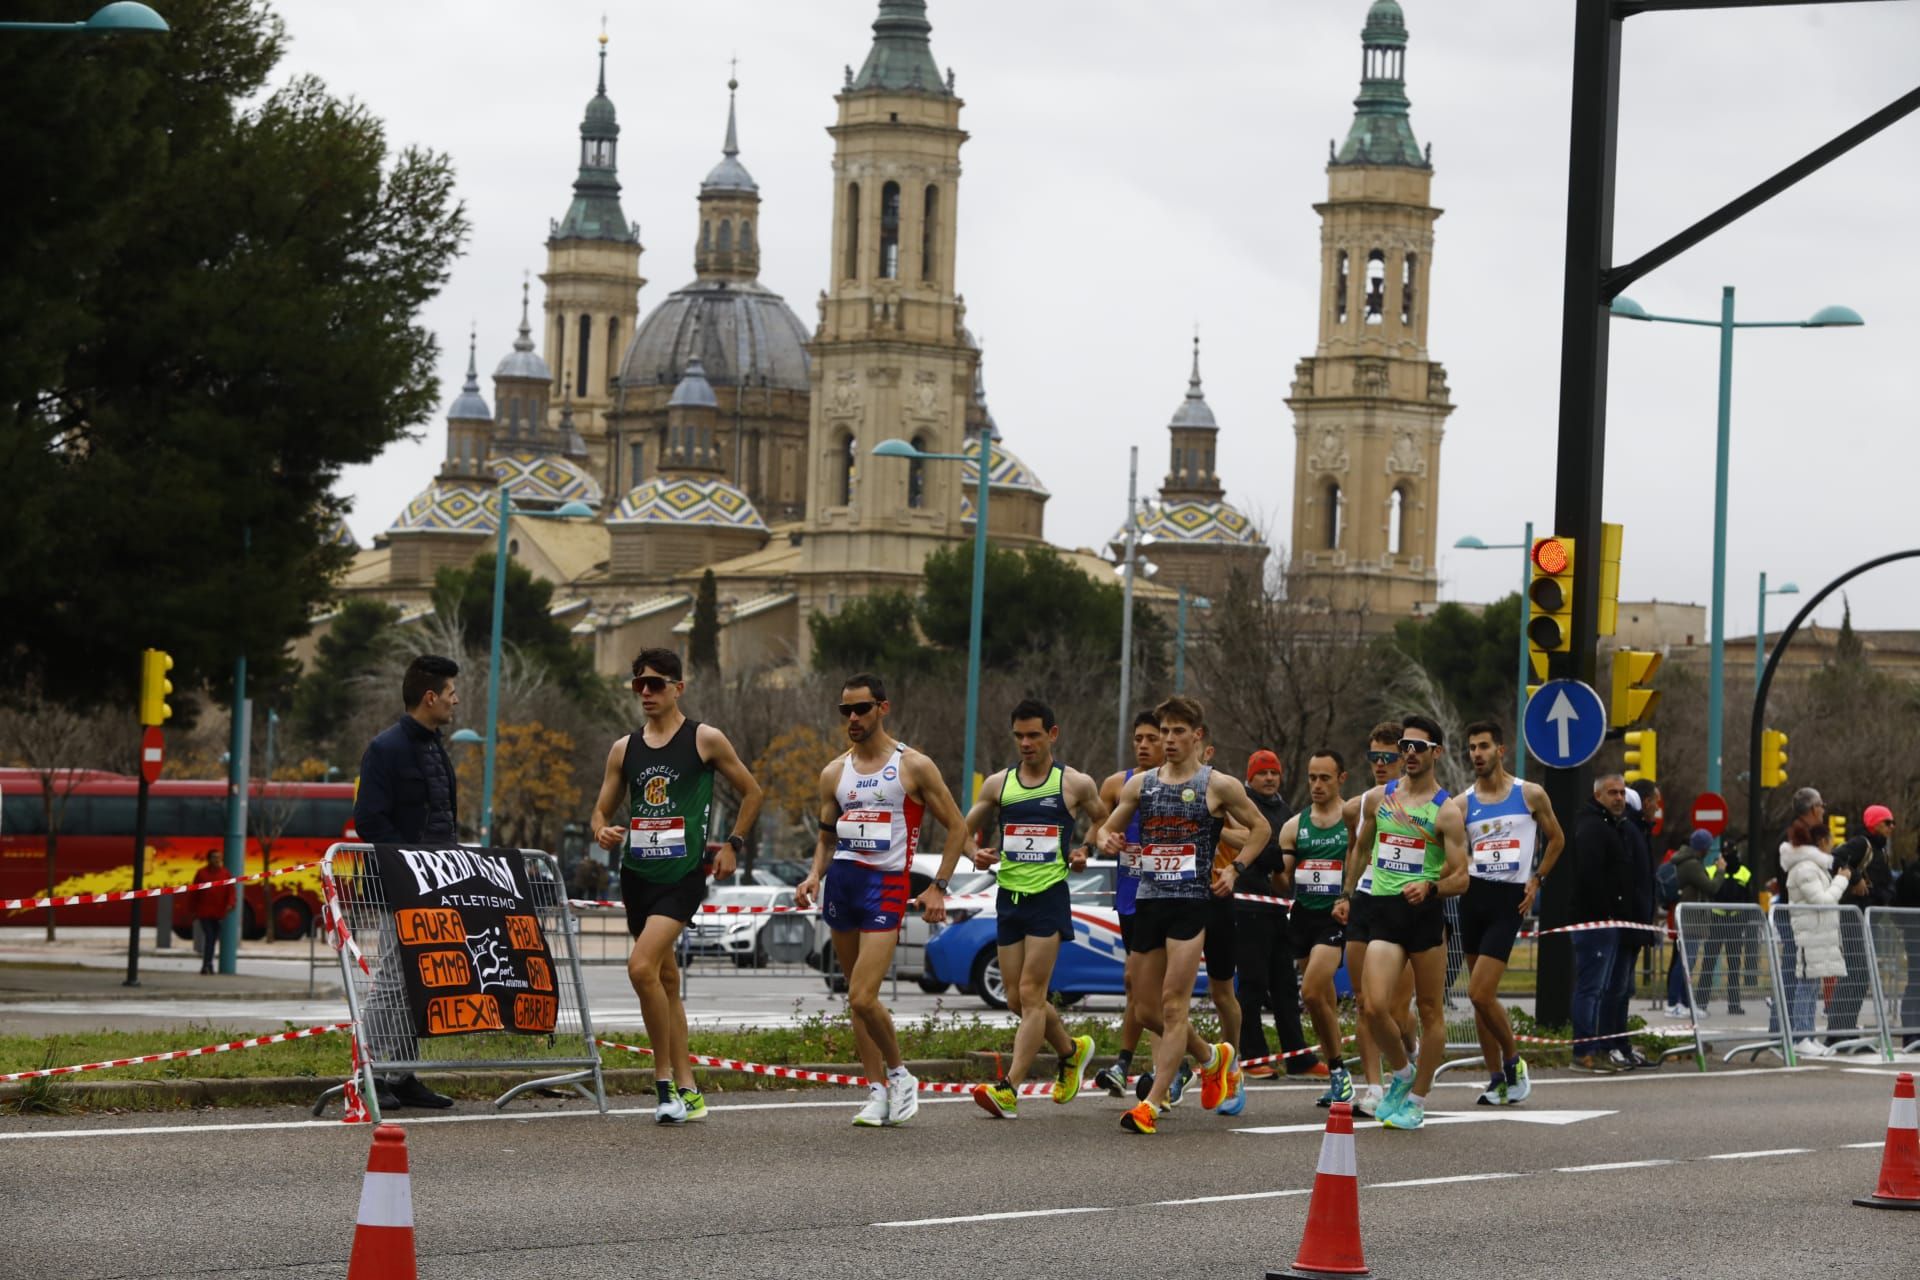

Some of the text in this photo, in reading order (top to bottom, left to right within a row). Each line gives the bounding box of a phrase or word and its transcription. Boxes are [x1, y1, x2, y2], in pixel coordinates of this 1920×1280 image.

[856, 779, 879, 789] aula
[859, 824, 865, 837] 1
[649, 832, 659, 846] 4
[1025, 838, 1034, 851] 2
[1393, 848, 1401, 860] 3
[1493, 851, 1501, 863] 9
[1154, 858, 1180, 871] 372
[1313, 872, 1320, 883] 8
[441, 895, 516, 909] ATLETISMO
[398, 911, 464, 941] LAURA
[421, 955, 468, 985] EMMA
[429, 996, 499, 1030] ALEXIA
